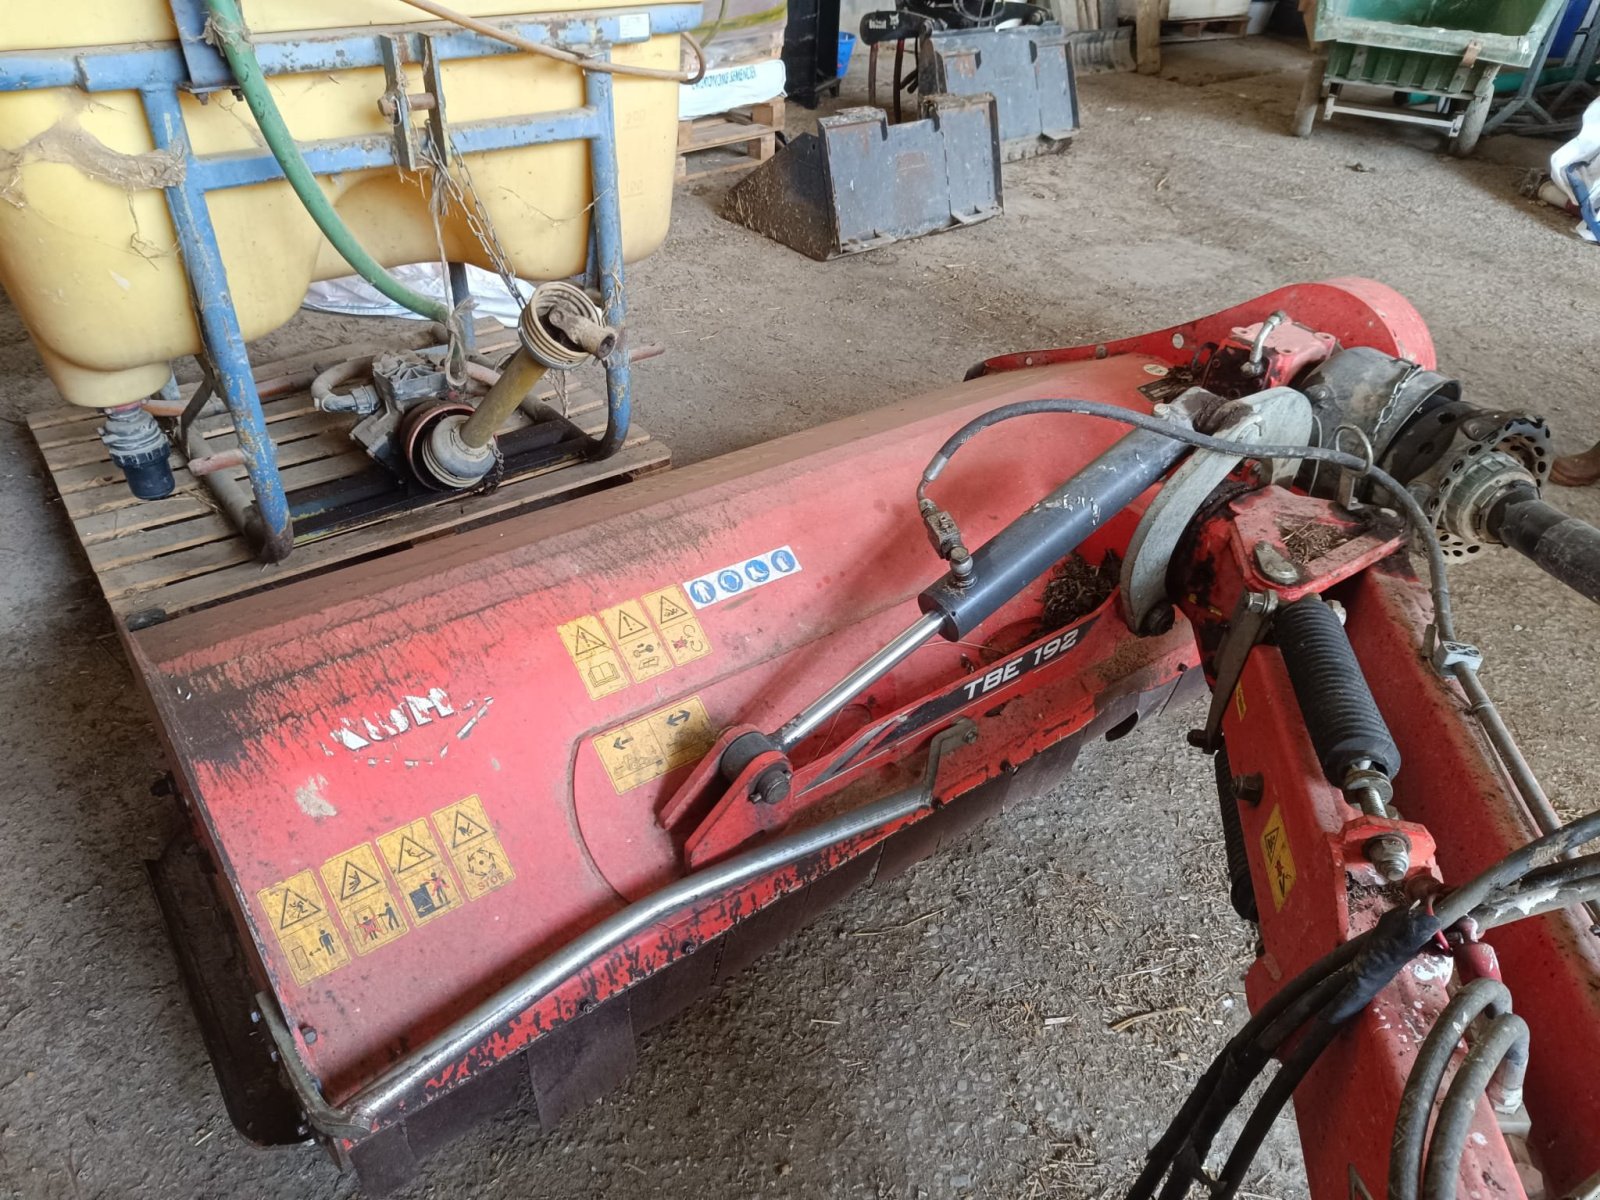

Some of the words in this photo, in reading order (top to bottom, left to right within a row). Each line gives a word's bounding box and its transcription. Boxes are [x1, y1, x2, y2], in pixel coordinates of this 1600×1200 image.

[964, 657, 1023, 700] TBE
[1033, 628, 1079, 666] 192
[477, 871, 504, 891] STOP
